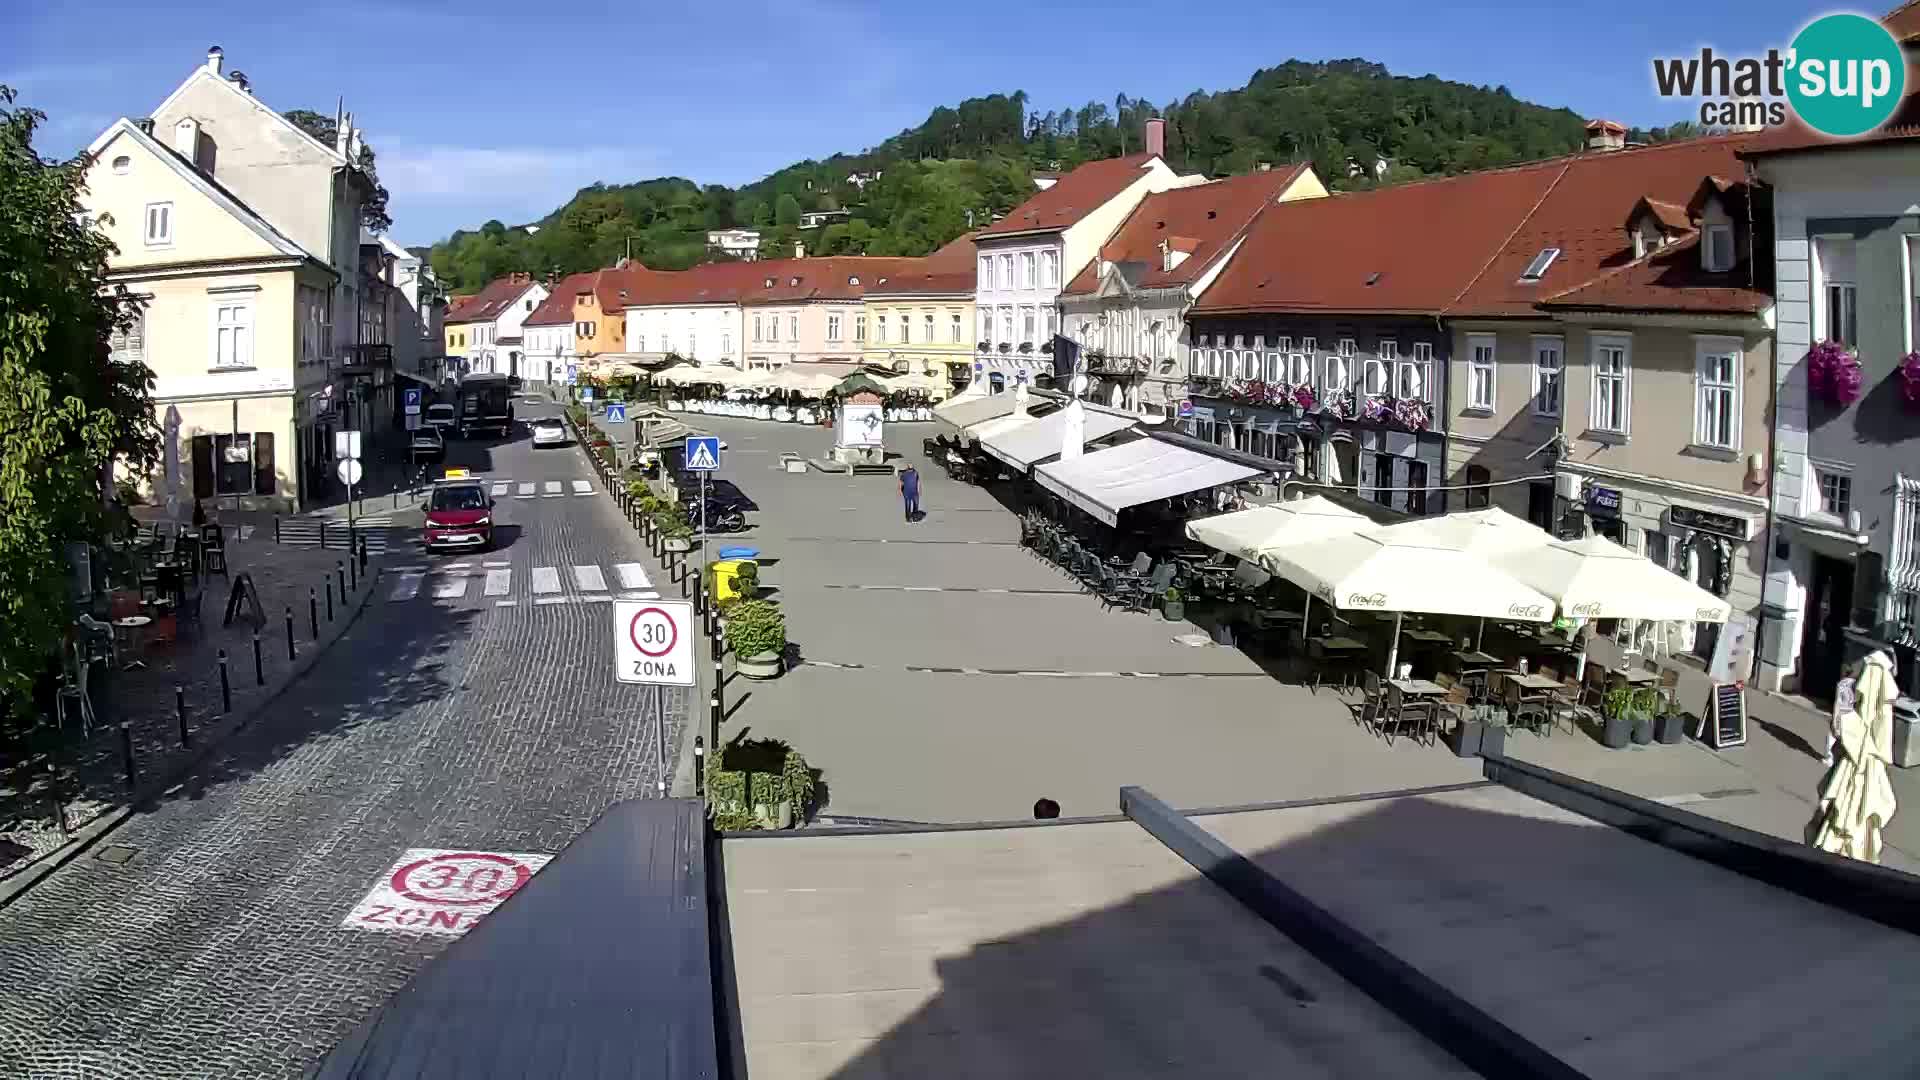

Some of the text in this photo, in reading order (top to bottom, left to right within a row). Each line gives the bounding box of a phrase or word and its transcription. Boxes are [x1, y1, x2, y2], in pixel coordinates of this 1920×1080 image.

[642, 623, 666, 644] 30
[633, 660, 676, 677] ZONA
[419, 865, 504, 893] 30
